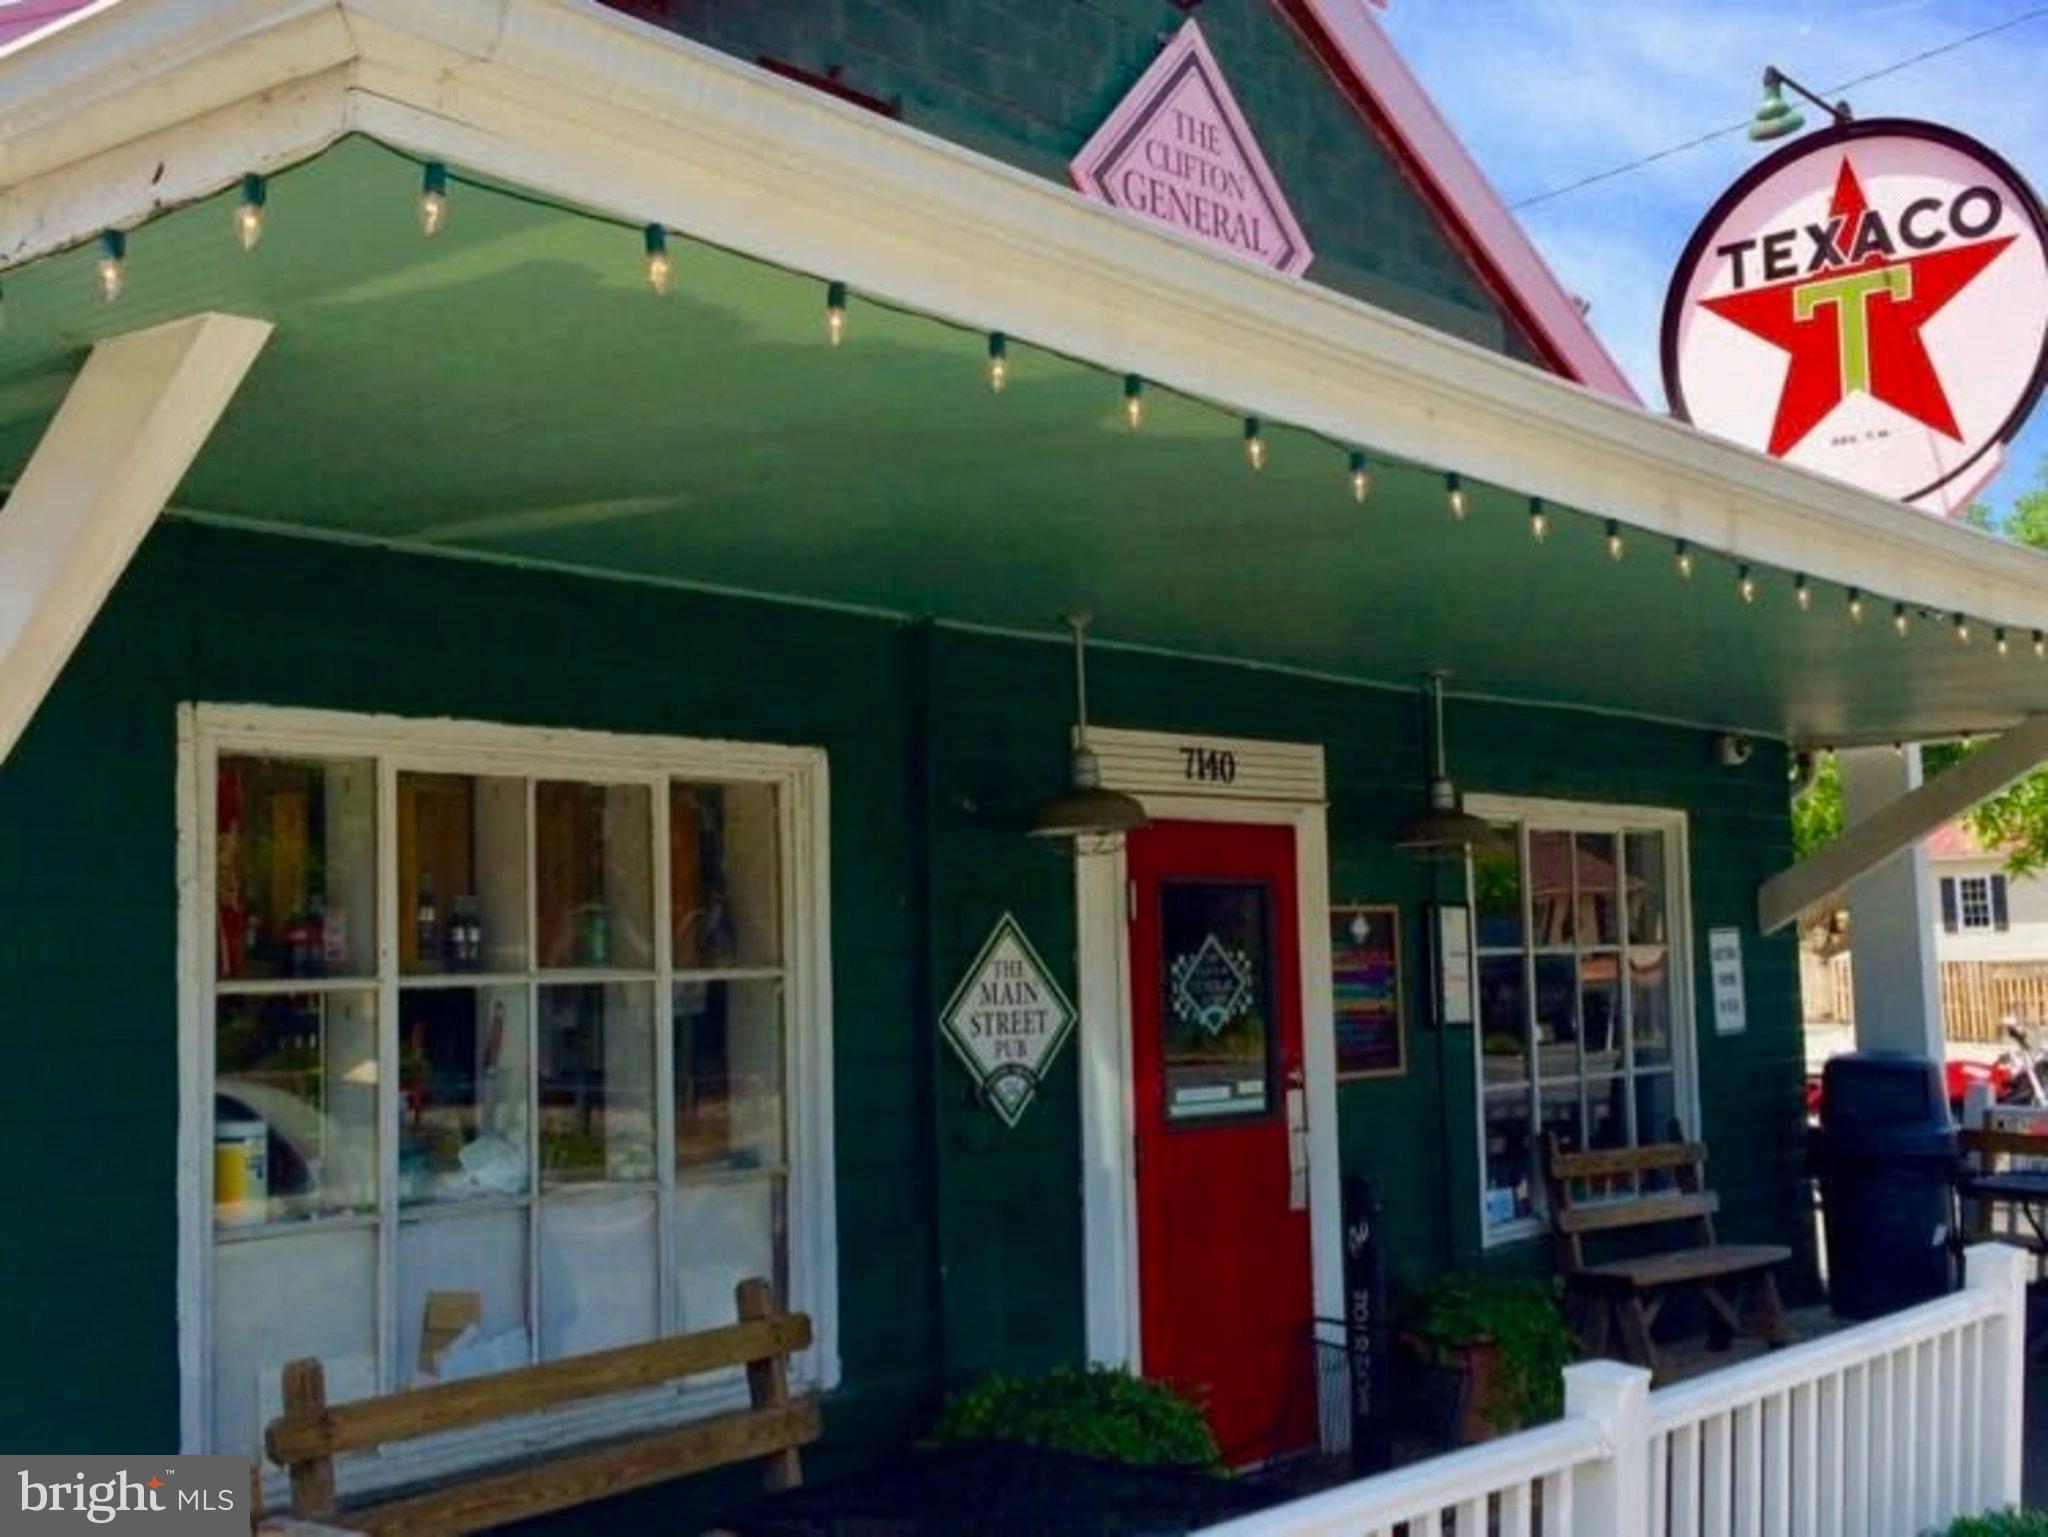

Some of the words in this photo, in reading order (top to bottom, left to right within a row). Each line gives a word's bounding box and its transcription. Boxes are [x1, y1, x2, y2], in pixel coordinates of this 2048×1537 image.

[1172, 109, 1221, 156] THE
[1146, 139, 1247, 200] CLIFTON
[1123, 170, 1268, 255] GENERAL
[1716, 186, 2001, 289] TEXACO
[1793, 262, 1913, 396] T
[1179, 747, 1235, 784] 7140
[994, 960, 1023, 978] THE
[980, 982, 1039, 1005] MAIN
[970, 1010, 1049, 1037] STREET
[994, 1040, 1028, 1059] PUB
